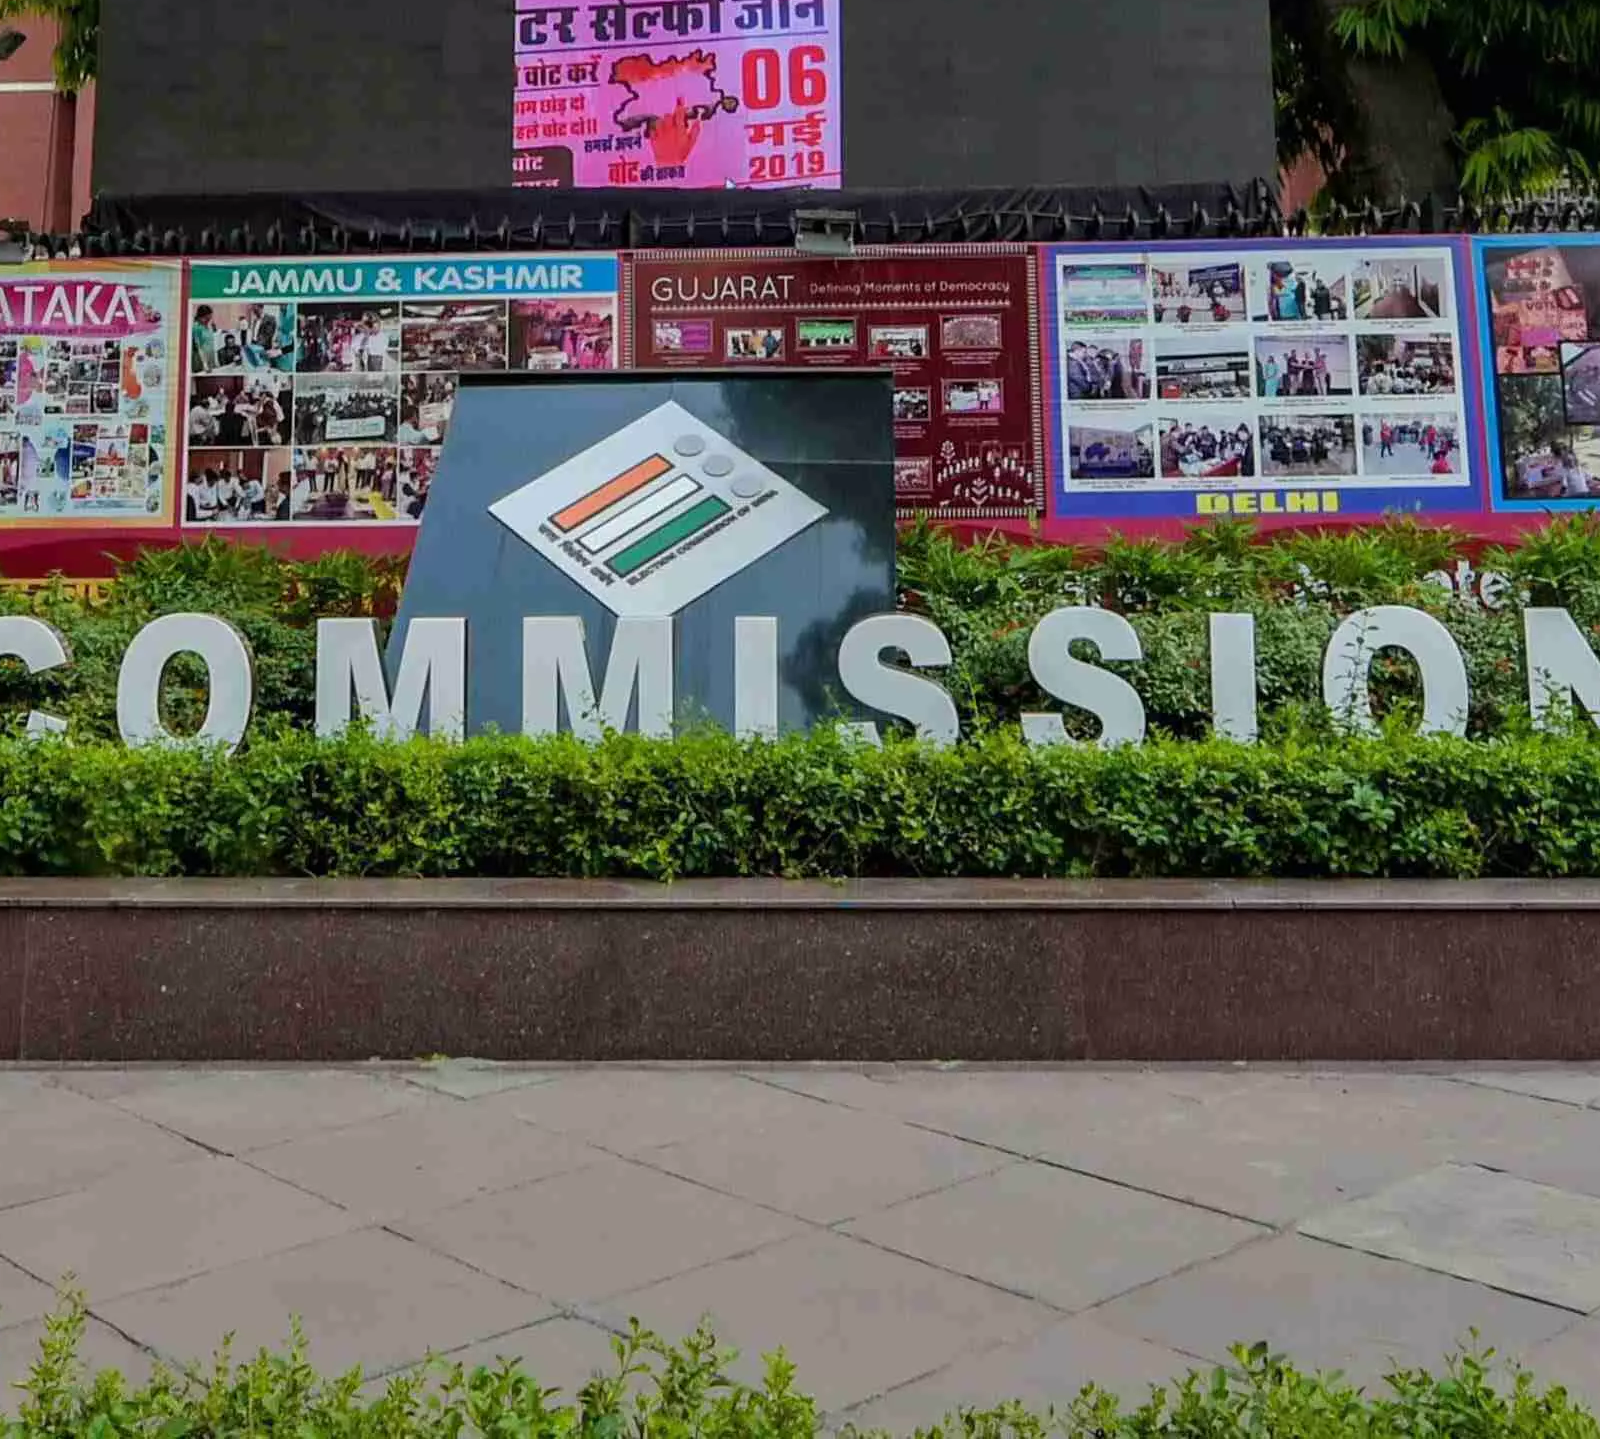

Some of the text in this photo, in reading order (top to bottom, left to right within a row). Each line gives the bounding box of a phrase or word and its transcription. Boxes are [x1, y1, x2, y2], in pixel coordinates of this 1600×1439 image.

[523, 55, 602, 87] वोट करें
[742, 46, 828, 110] 06
[745, 113, 827, 147] मई
[608, 155, 639, 184] वोट
[749, 151, 825, 180] 2019
[223, 264, 584, 295] JAMMU & KASHMIR
[651, 274, 1010, 302] GUJARAT Defining Moments of Democracy
[1196, 490, 1339, 514] DELHI
[626, 552, 674, 586] ELECTION
